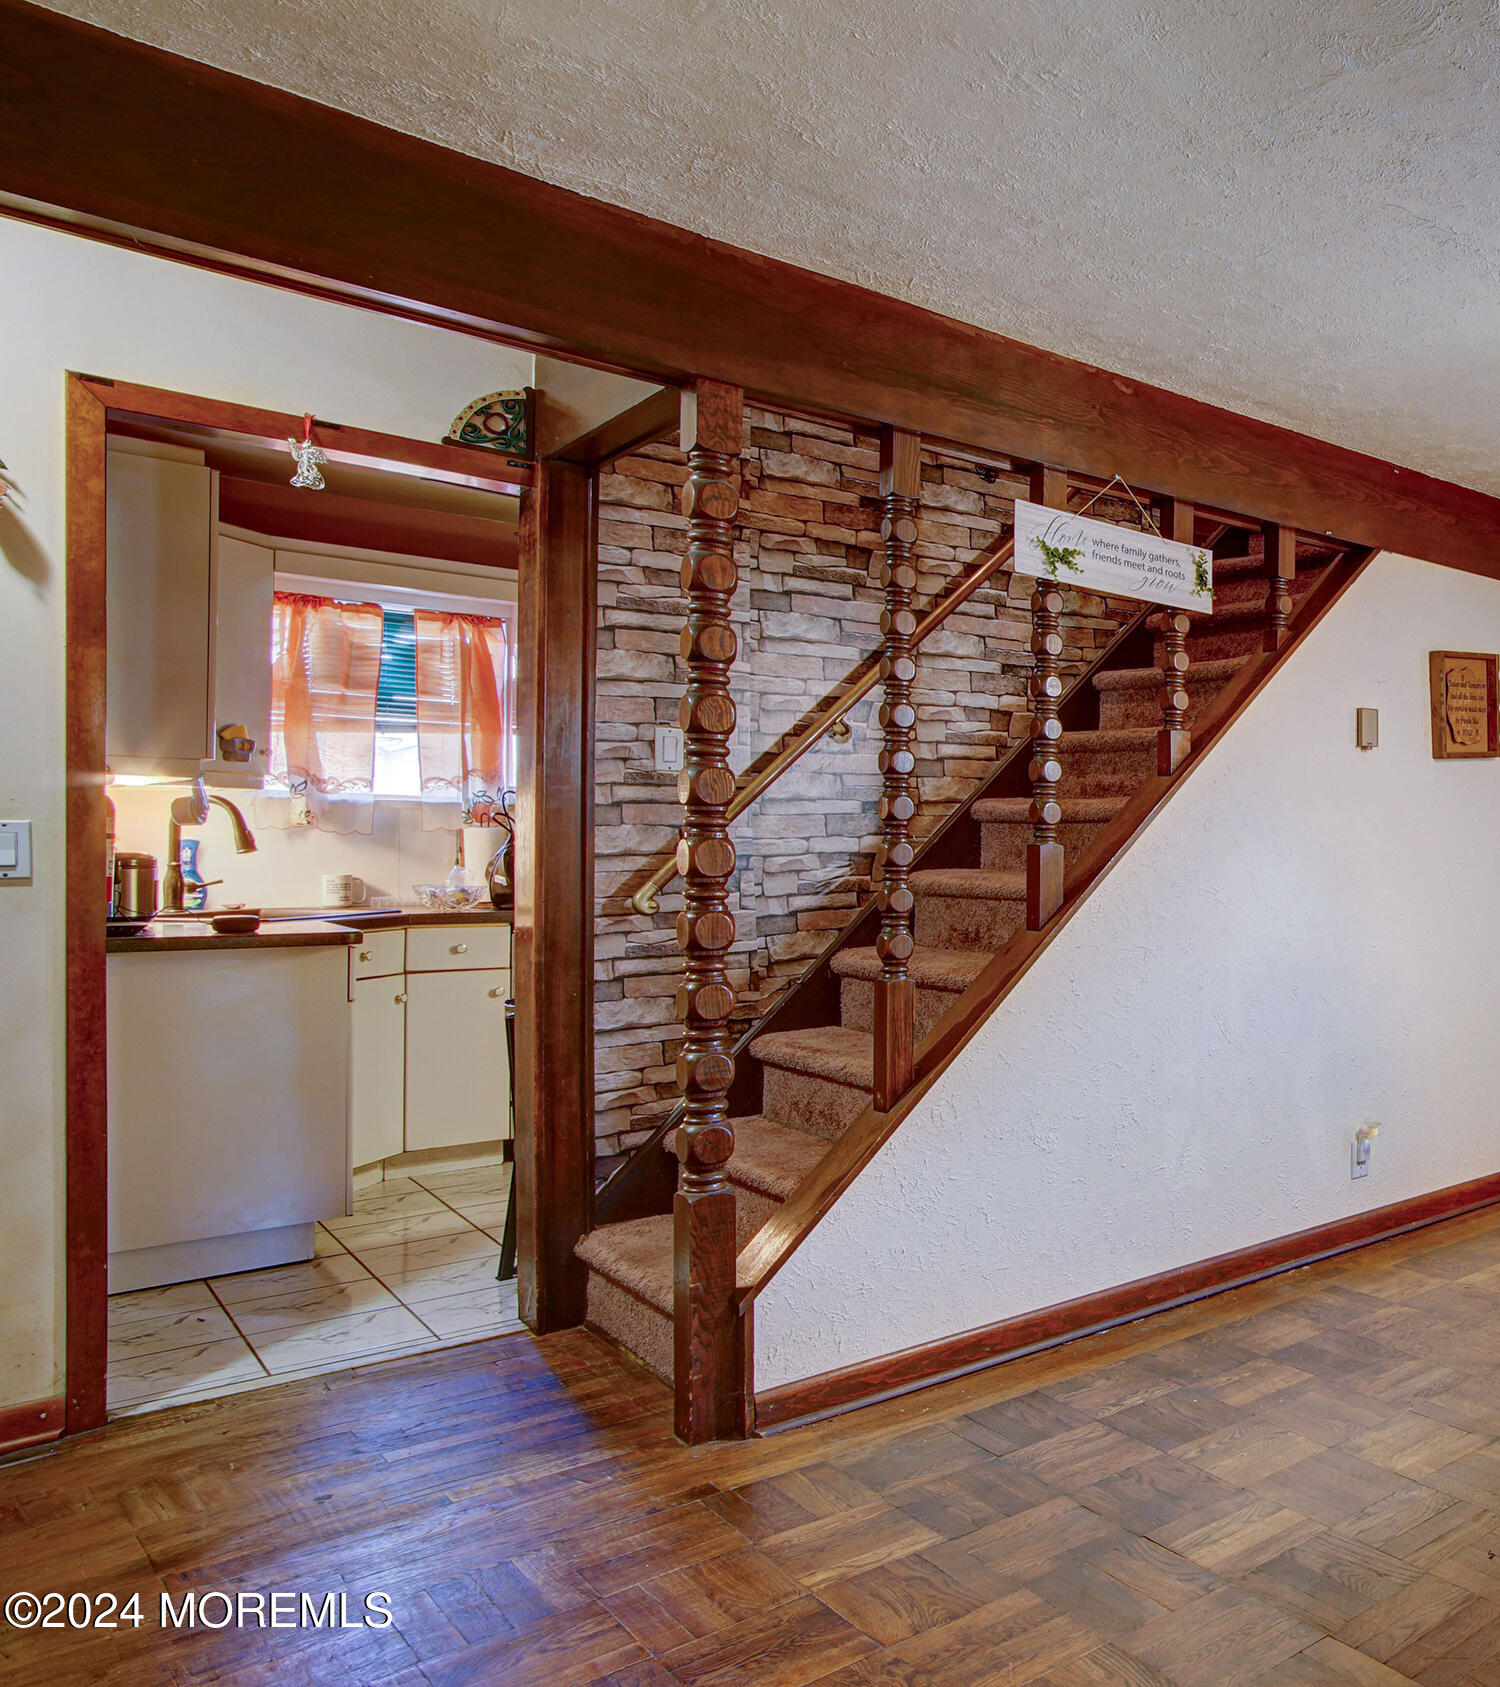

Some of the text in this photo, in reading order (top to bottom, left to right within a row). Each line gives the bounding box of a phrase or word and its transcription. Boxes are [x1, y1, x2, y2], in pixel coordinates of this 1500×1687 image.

[1092, 537, 1181, 568] where family gathers,
[1092, 551, 1186, 581] friends meet and roots
[1129, 575, 1180, 593] grow
